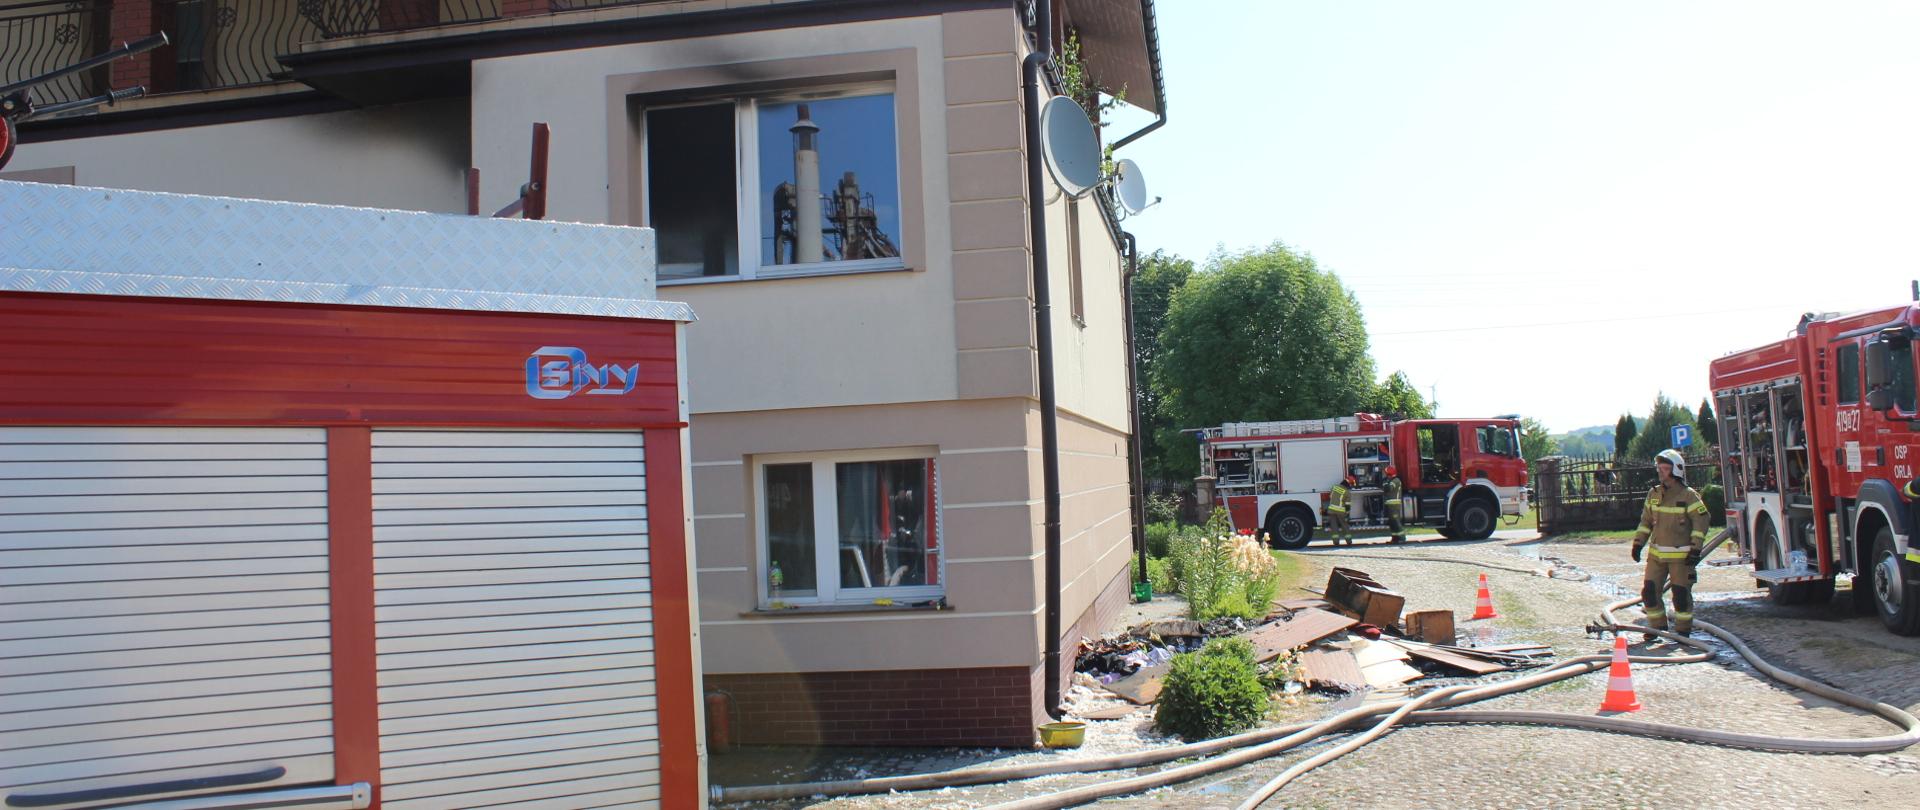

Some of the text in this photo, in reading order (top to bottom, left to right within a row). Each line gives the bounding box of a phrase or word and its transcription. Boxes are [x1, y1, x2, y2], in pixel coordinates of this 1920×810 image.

[1676, 428, 1687, 444] P
[1894, 445, 1908, 459] OSP
[1894, 464, 1913, 479] ORLA
